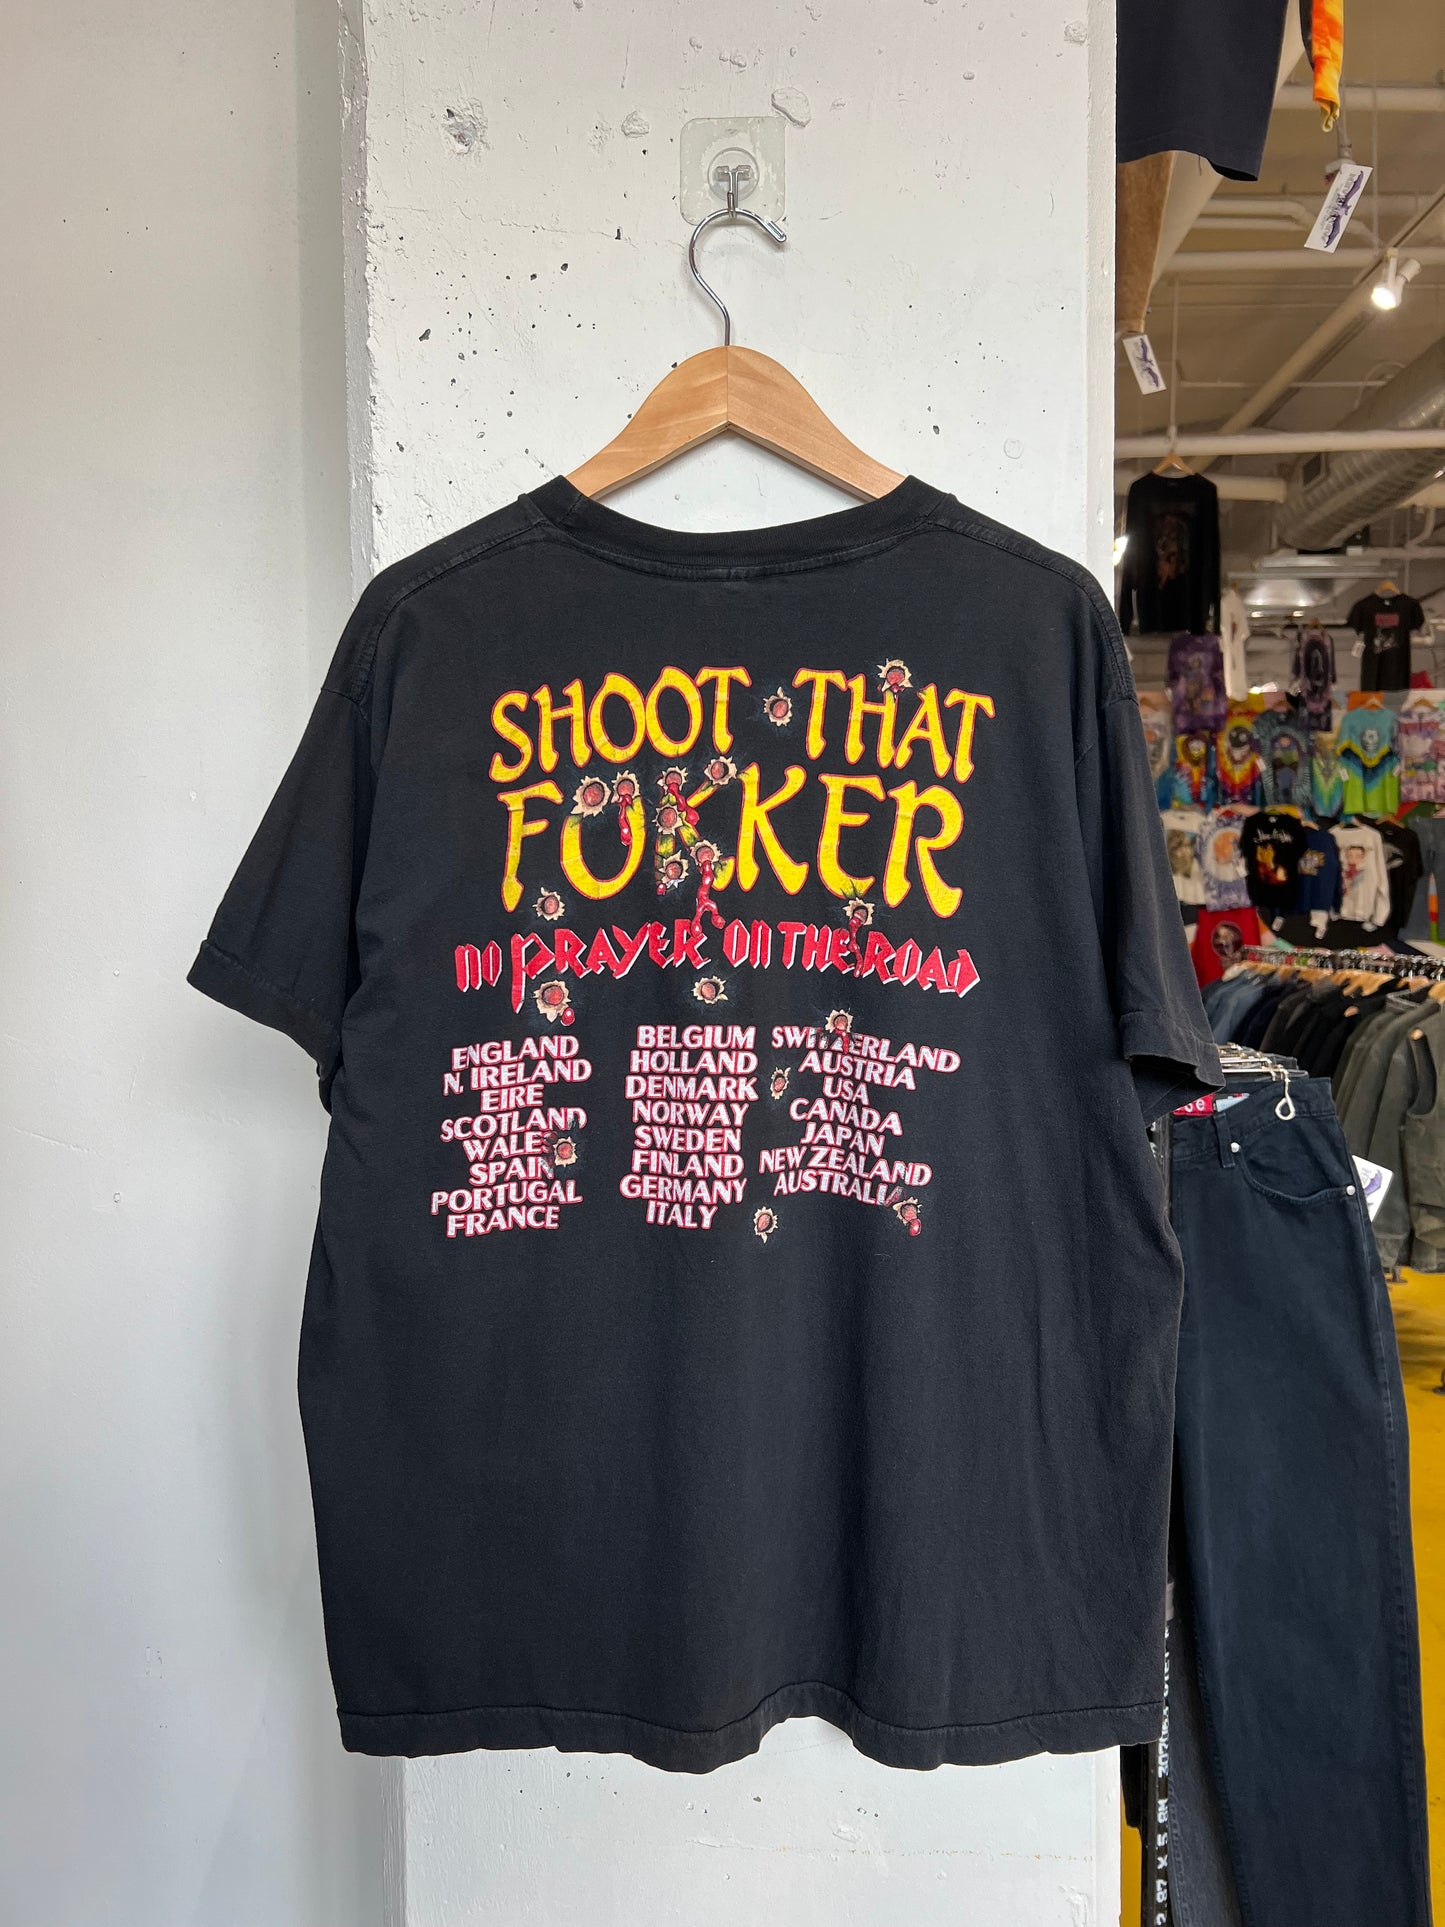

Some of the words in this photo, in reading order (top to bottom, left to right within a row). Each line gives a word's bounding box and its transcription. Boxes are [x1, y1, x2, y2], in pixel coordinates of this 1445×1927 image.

[489, 666, 752, 783] SHOOT
[793, 667, 996, 783] THAT
[511, 919, 711, 1014] PRAYER
[777, 921, 855, 974] THE
[862, 930, 980, 998] ROAD
[452, 1035, 579, 1071] ENGLAND
[636, 1025, 756, 1050] BELGIUM
[470, 1059, 592, 1090] IRELAND
[630, 1050, 758, 1075] HOLLAND
[798, 1050, 916, 1091] AUSTRIA
[481, 1084, 544, 1113] EIRE
[625, 1075, 759, 1101] DENMARK
[823, 1076, 869, 1106] USA
[440, 1107, 587, 1142] SCOTLAND
[632, 1100, 749, 1127] NORWAY
[789, 1097, 903, 1136] CANADA
[634, 1125, 741, 1153] SWEDEN
[800, 1122, 885, 1158] JAPAN
[468, 1156, 555, 1185] SPAIN
[631, 1150, 744, 1178] FINLAND
[759, 1146, 806, 1174] NEW
[807, 1147, 932, 1186] ZEALAND
[431, 1179, 583, 1215] PORTUGAL
[619, 1174, 747, 1205] GERMANY
[446, 1205, 560, 1238] FRANCE
[646, 1200, 718, 1230] ITALY
